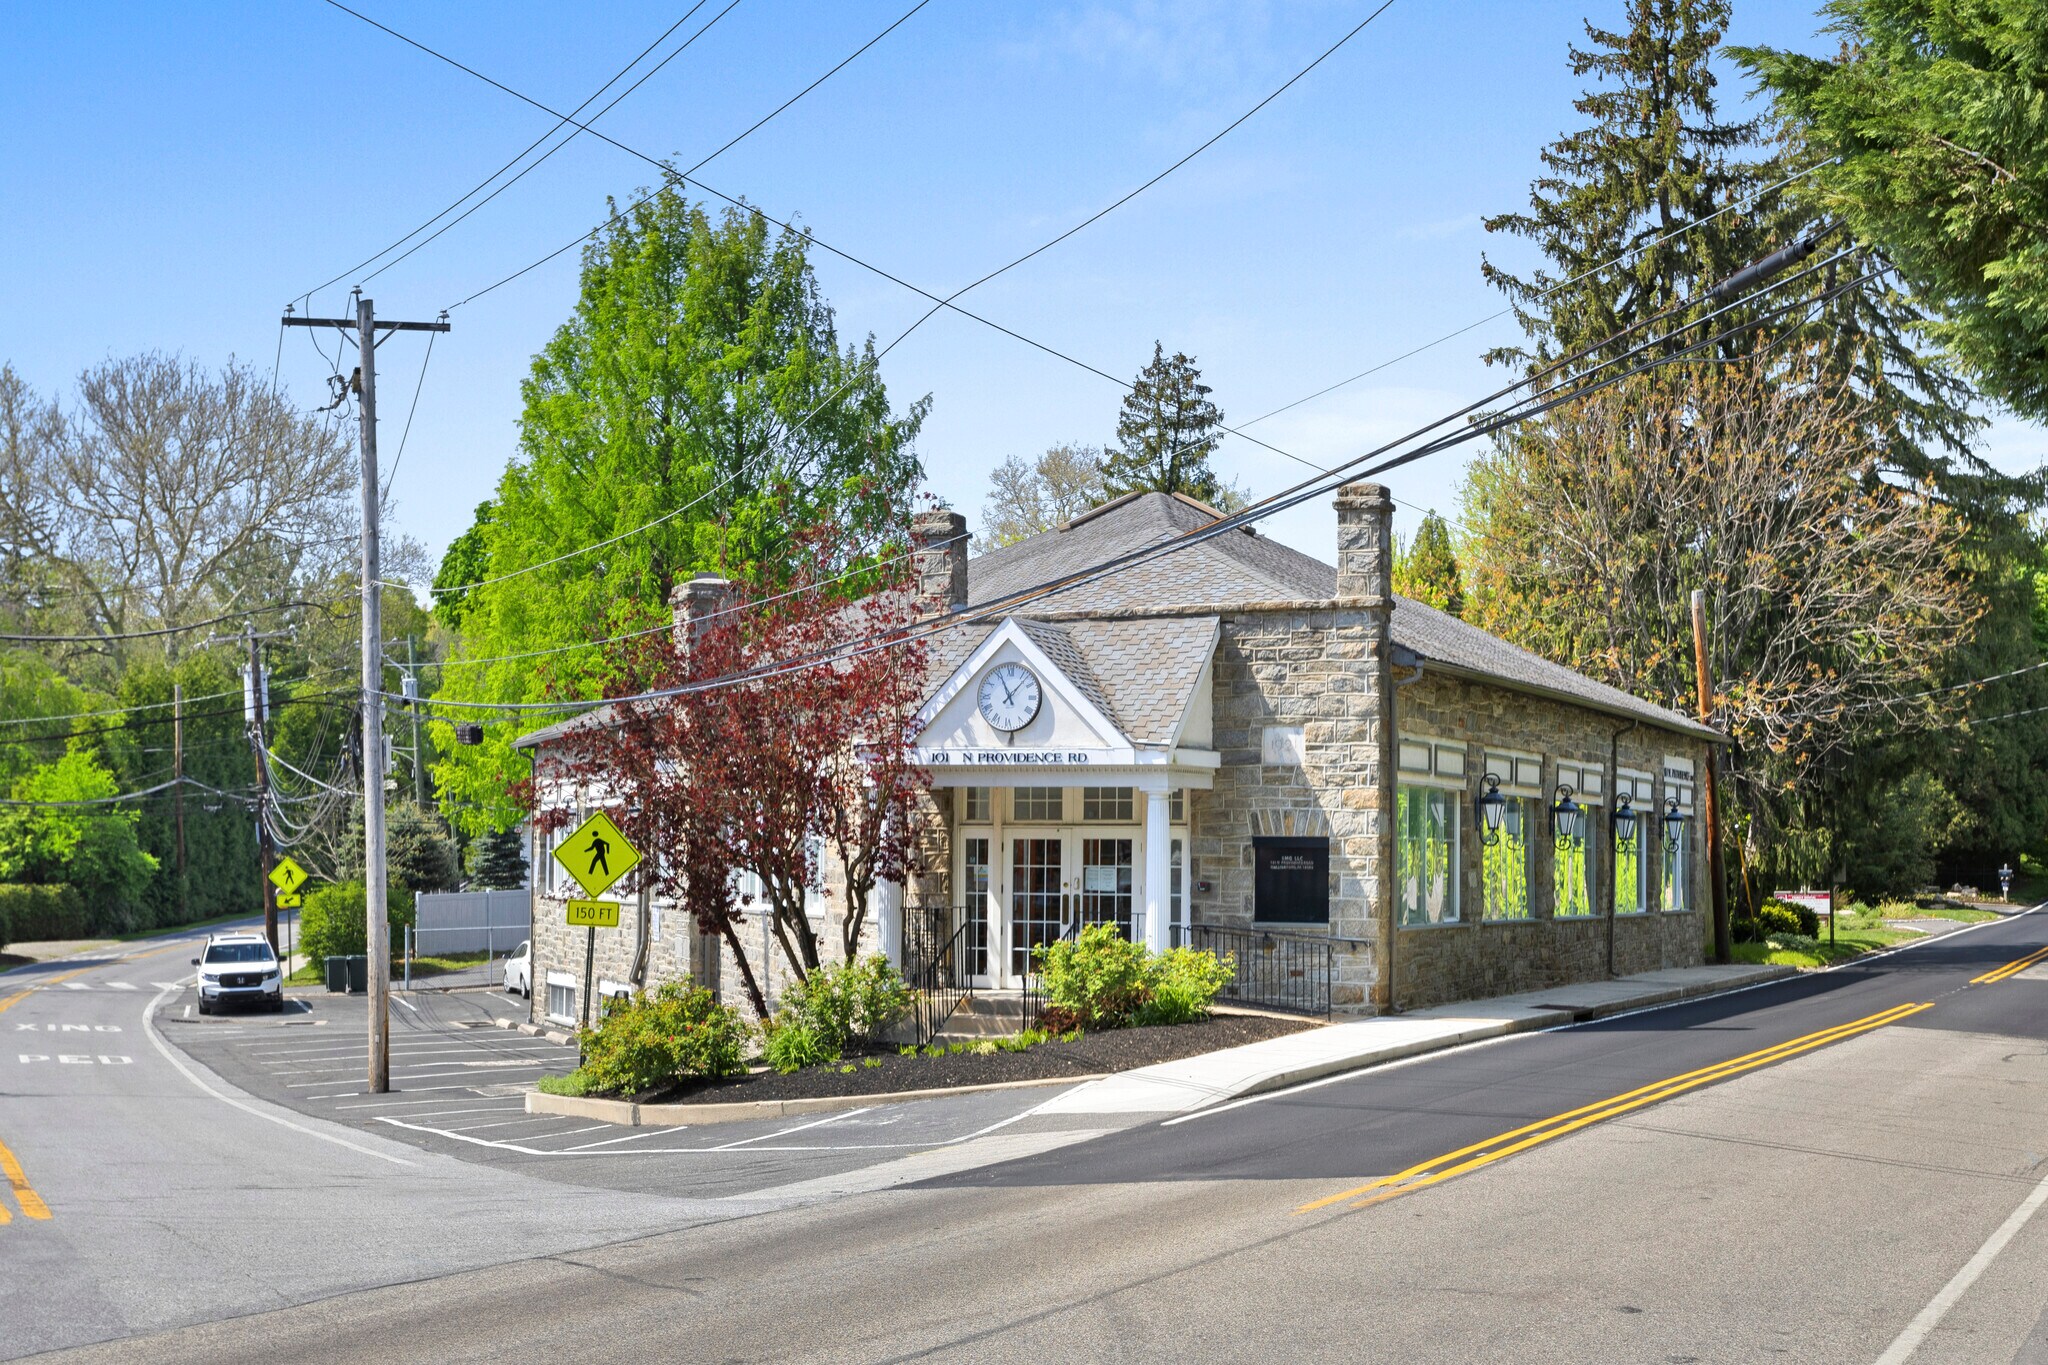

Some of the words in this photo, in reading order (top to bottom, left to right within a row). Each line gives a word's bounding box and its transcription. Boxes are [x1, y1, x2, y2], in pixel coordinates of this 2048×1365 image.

[962, 752, 974, 763] N
[978, 752, 1062, 763] PROVIDENCE
[1068, 752, 1088, 763] RD
[576, 907, 595, 919] 150
[599, 908, 612, 920] FT
[15, 1024, 123, 1032] XING
[18, 1054, 134, 1064] PED
